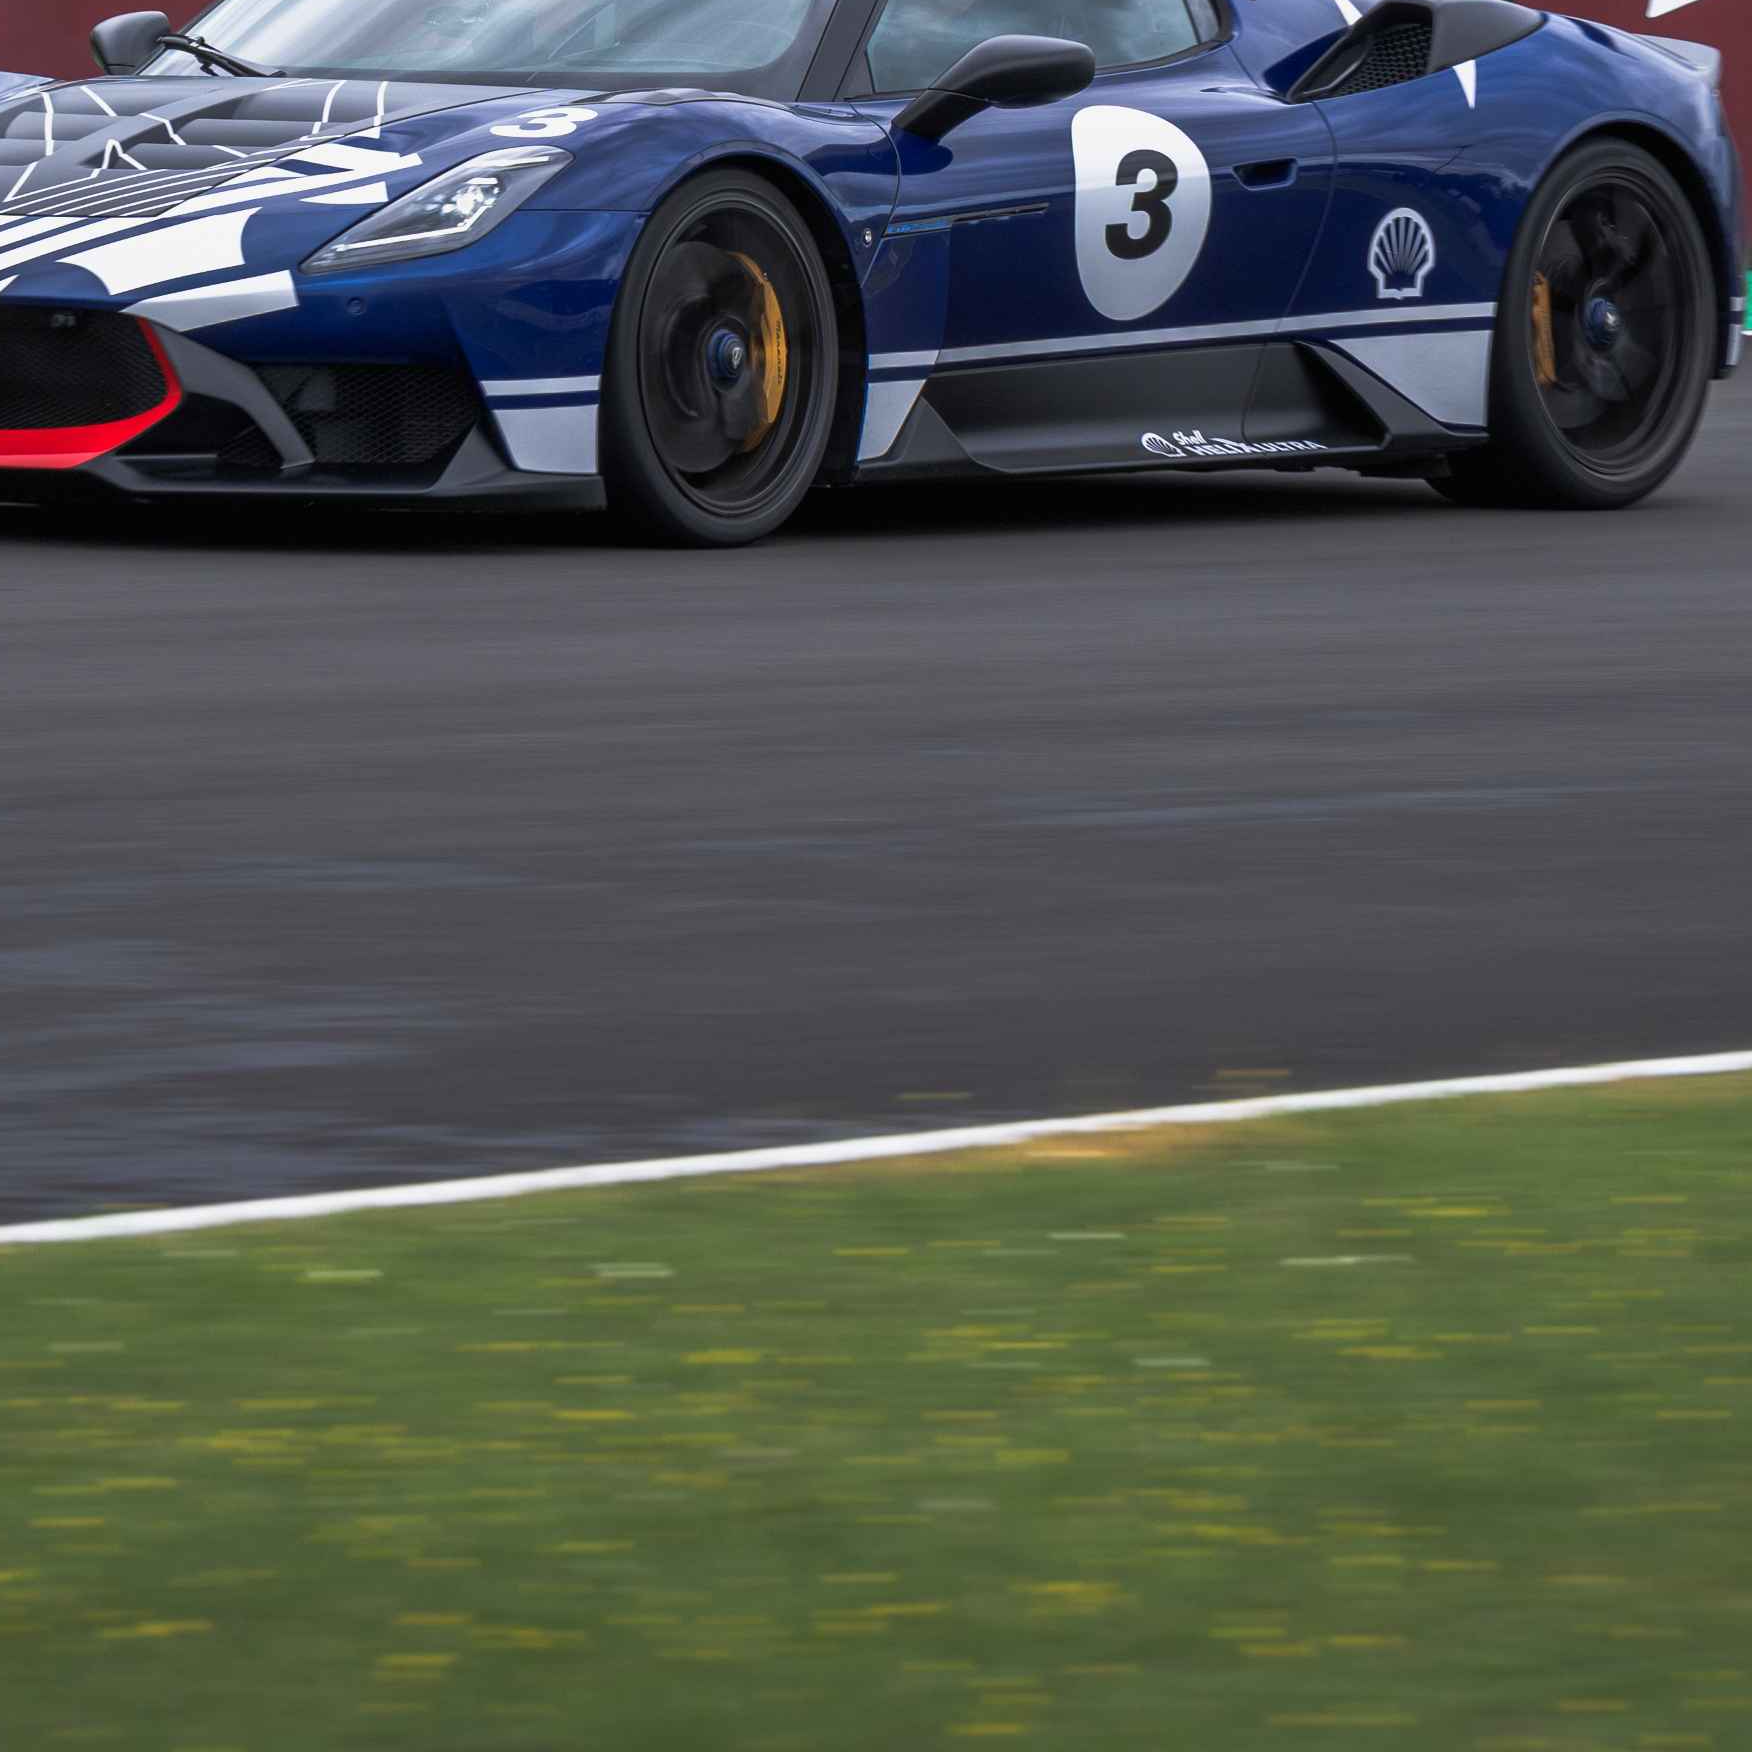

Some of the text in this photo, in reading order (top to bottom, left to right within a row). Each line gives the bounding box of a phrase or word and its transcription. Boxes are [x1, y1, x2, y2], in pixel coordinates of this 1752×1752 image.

[488, 107, 599, 138] 3
[1105, 149, 1178, 260] 3
[1172, 429, 1208, 446] Shell
[1251, 440, 1329, 453] ULTRA
